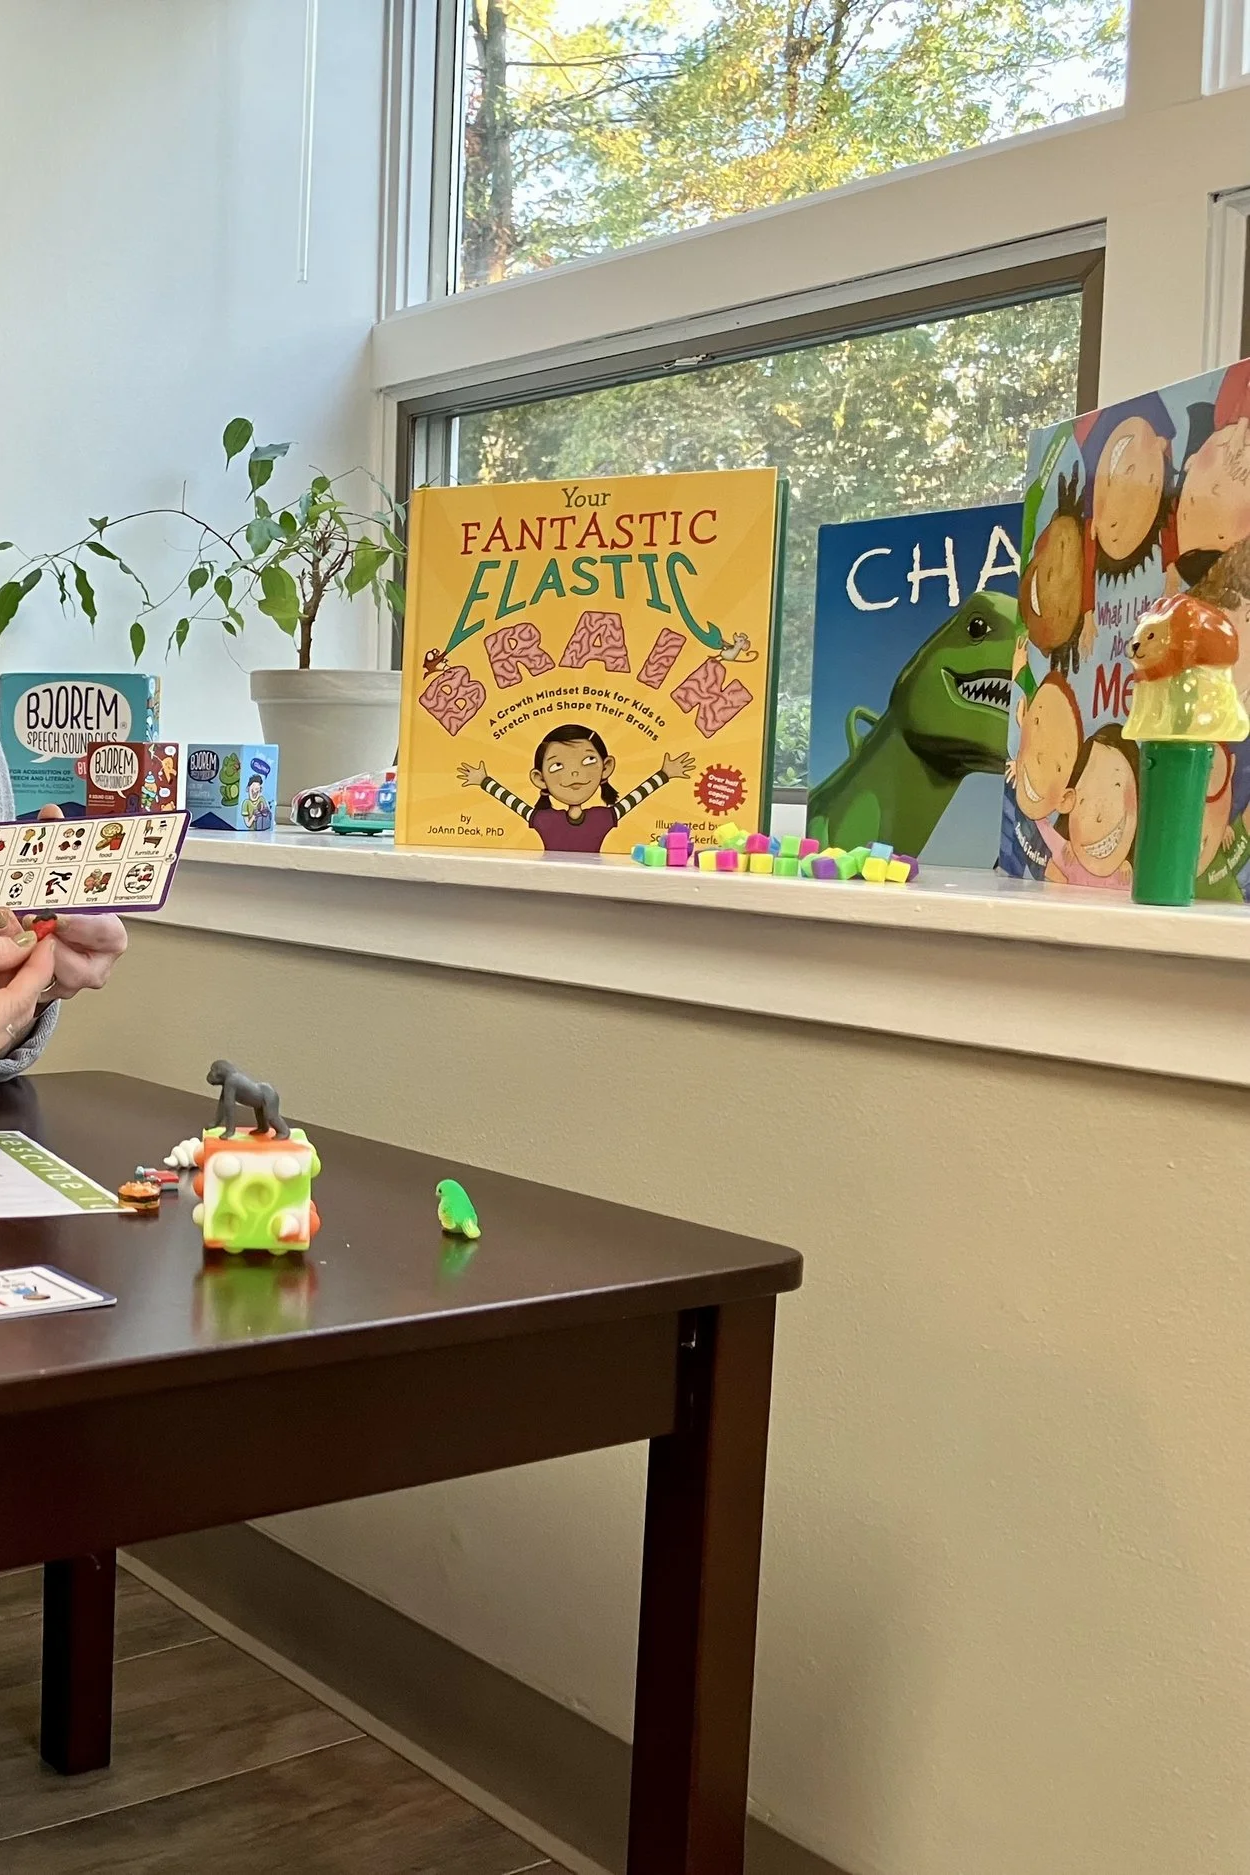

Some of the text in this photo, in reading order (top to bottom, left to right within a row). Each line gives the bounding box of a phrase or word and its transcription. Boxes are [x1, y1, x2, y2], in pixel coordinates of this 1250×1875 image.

[561, 486, 611, 508] Your
[460, 510, 717, 555] FANTASTIC
[445, 552, 724, 653] ELASTIC
[1097, 595, 1157, 630] What I Lik
[419, 611, 753, 738] BRAIN
[26, 685, 118, 730] BJOREM
[489, 686, 665, 727] A Growth Mindset Book for Kids to
[493, 701, 659, 741] Stretch and Shape Their Brains
[27, 731, 60, 753] SPEECH
[95, 747, 134, 775] BJOREM
[708, 774, 725, 783] Over
[712, 784, 735, 794] million
[457, 826, 484, 837] Deak,
[486, 827, 504, 836] PhD
[460, 813, 472, 824] by
